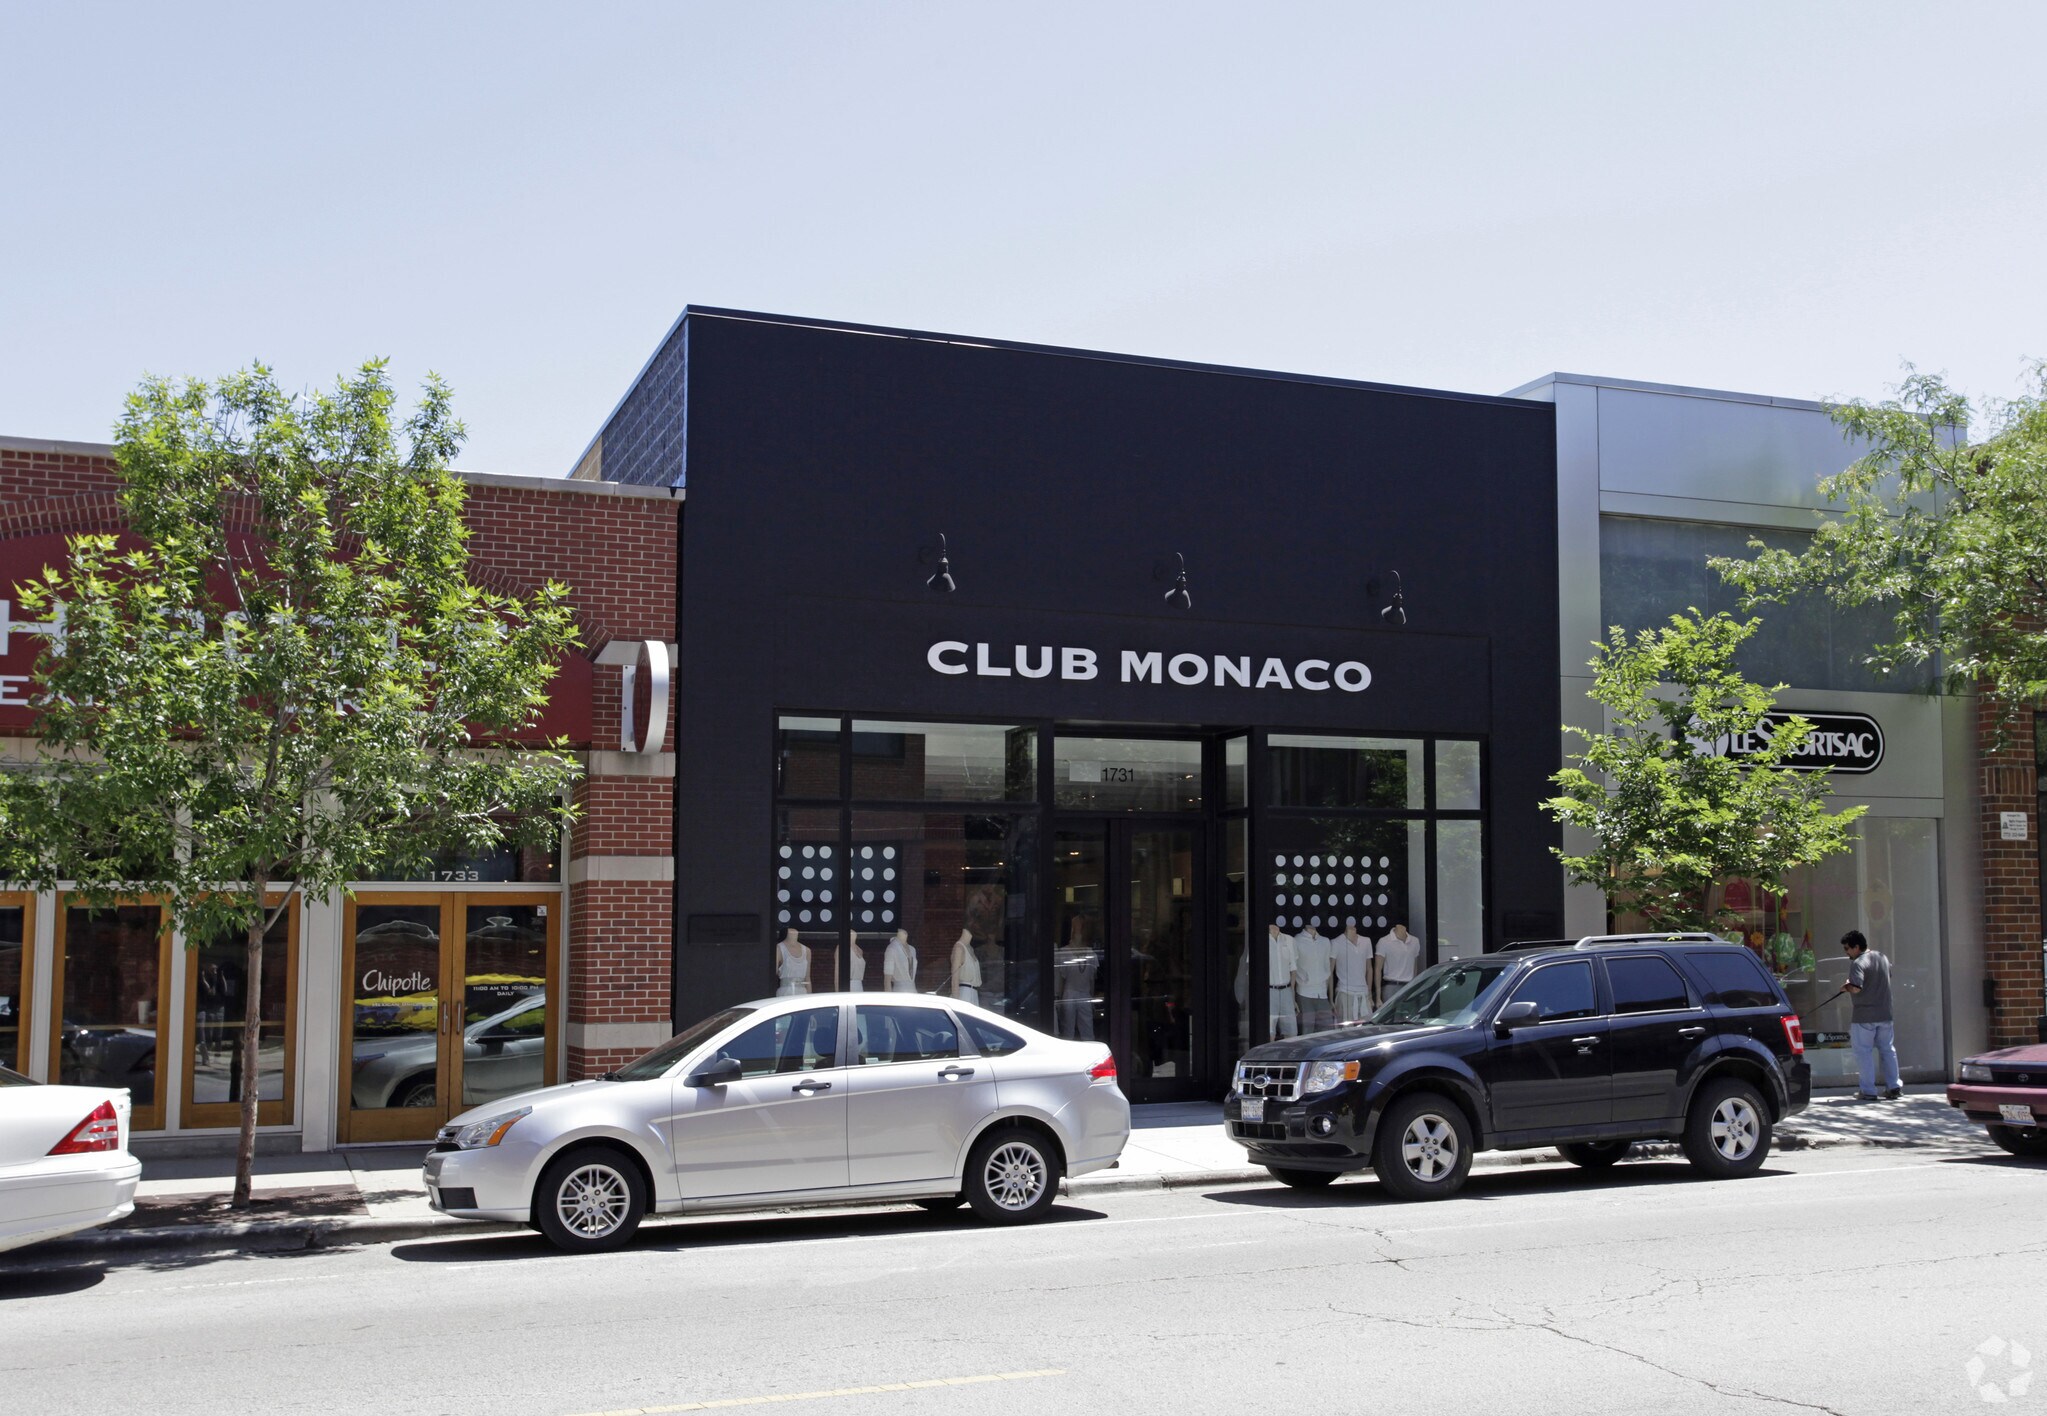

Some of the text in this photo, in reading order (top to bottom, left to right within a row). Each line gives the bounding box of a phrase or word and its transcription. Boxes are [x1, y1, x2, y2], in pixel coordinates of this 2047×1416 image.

[927, 640, 1372, 692] CLUB MONACO
[1101, 767, 1134, 783] 1731
[430, 870, 480, 882] 1733
[362, 969, 431, 997] Chipotle
